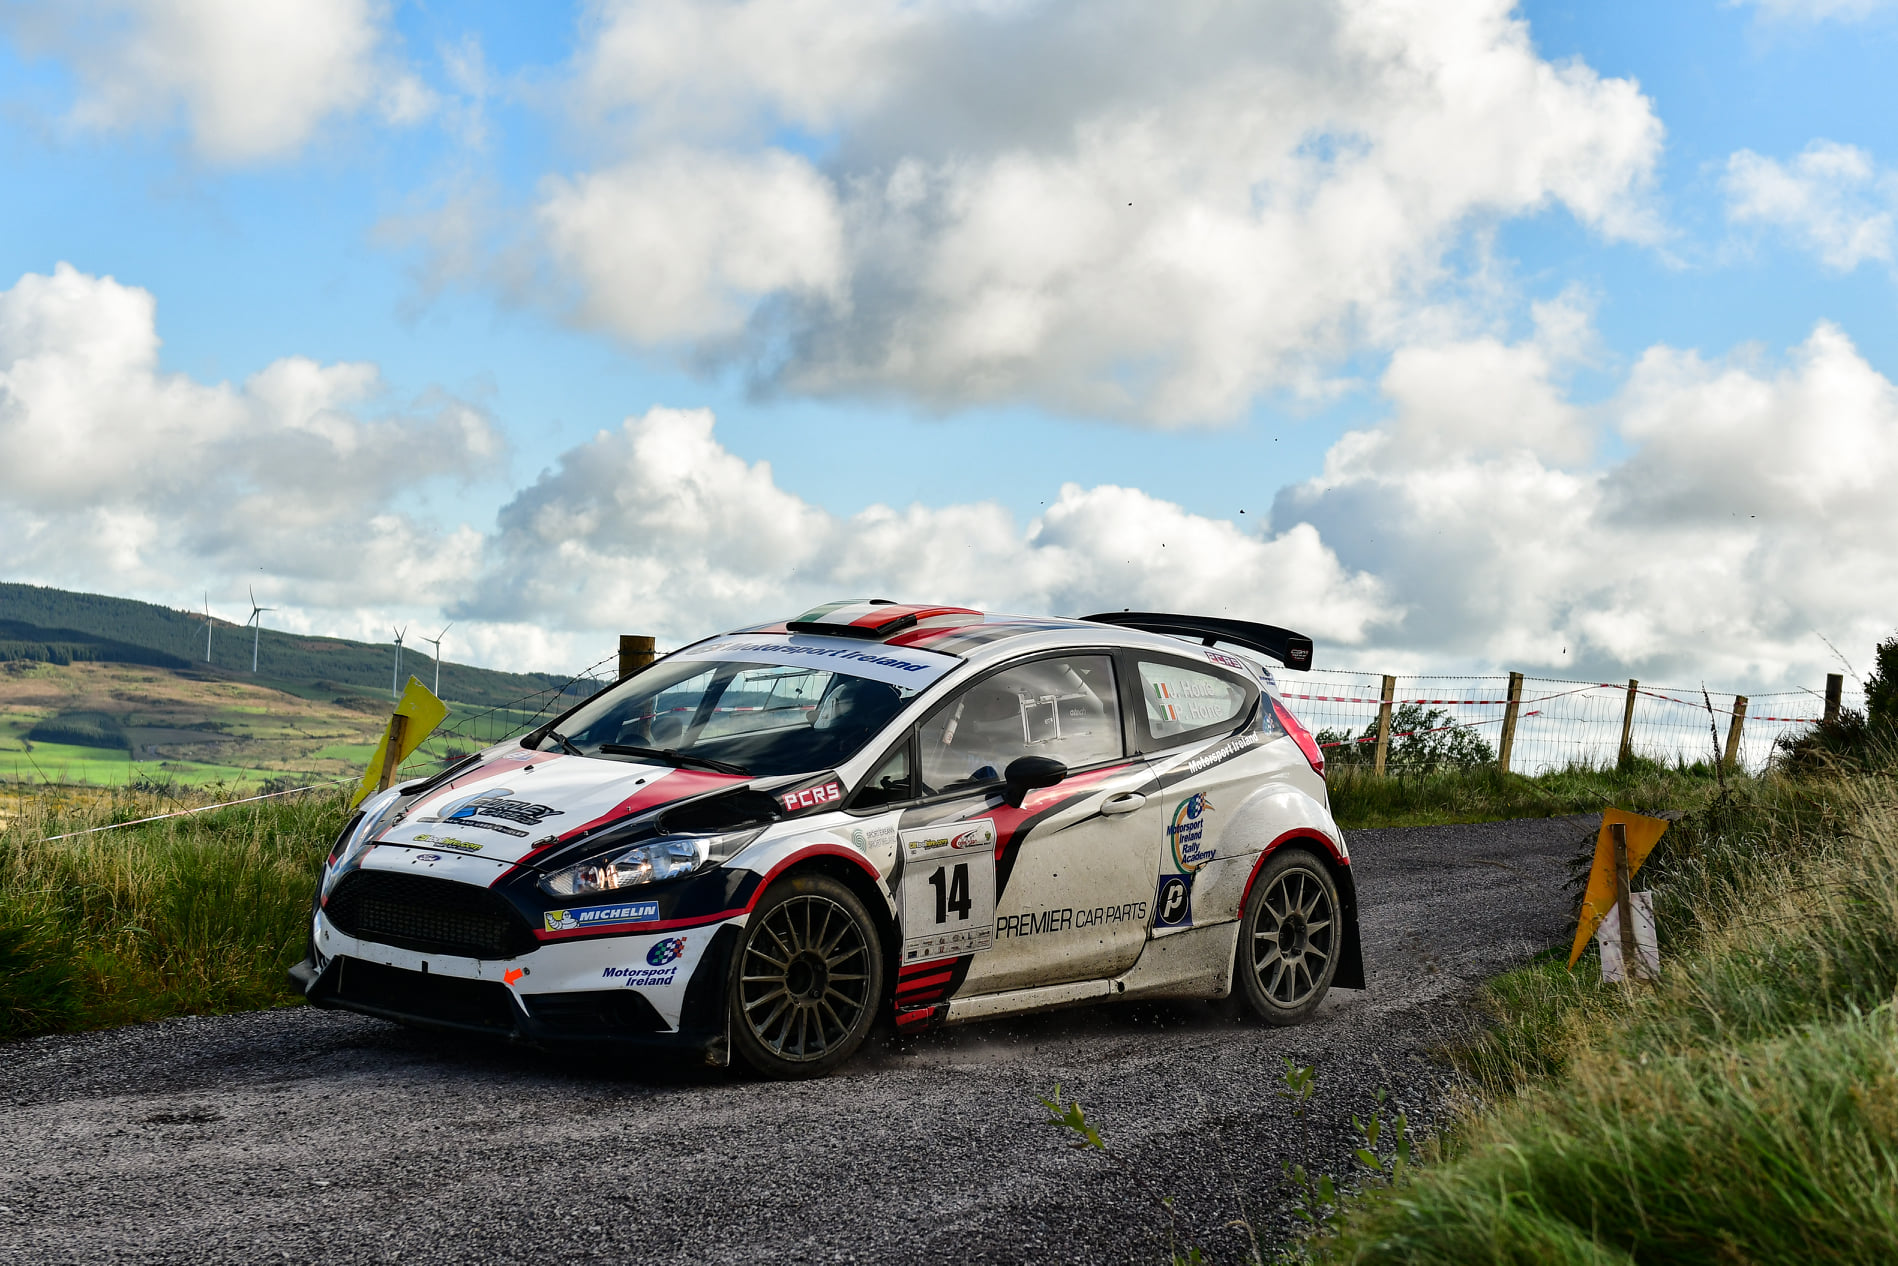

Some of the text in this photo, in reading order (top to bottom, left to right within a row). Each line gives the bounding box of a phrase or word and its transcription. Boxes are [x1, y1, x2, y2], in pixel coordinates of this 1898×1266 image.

[727, 642, 930, 672] Motorsport Ireland
[1205, 653, 1242, 668] PCRS
[1182, 680, 1215, 697] Hone
[1189, 702, 1221, 719] Hone
[1188, 731, 1259, 774] Motorsport Ireland
[783, 783, 840, 810] PCRS
[1167, 818, 1203, 836] Motorsport
[1179, 830, 1202, 844] Ireland
[1182, 842, 1200, 855] Rally
[1182, 849, 1216, 864] Academy
[929, 863, 972, 924] 14
[579, 906, 656, 921] MICHELIN
[996, 908, 1073, 939] PREMIER
[1075, 908, 1104, 928] CAR
[1105, 902, 1147, 924] PARTS
[602, 966, 677, 978] Motorsport
[626, 975, 674, 987] Ireland
